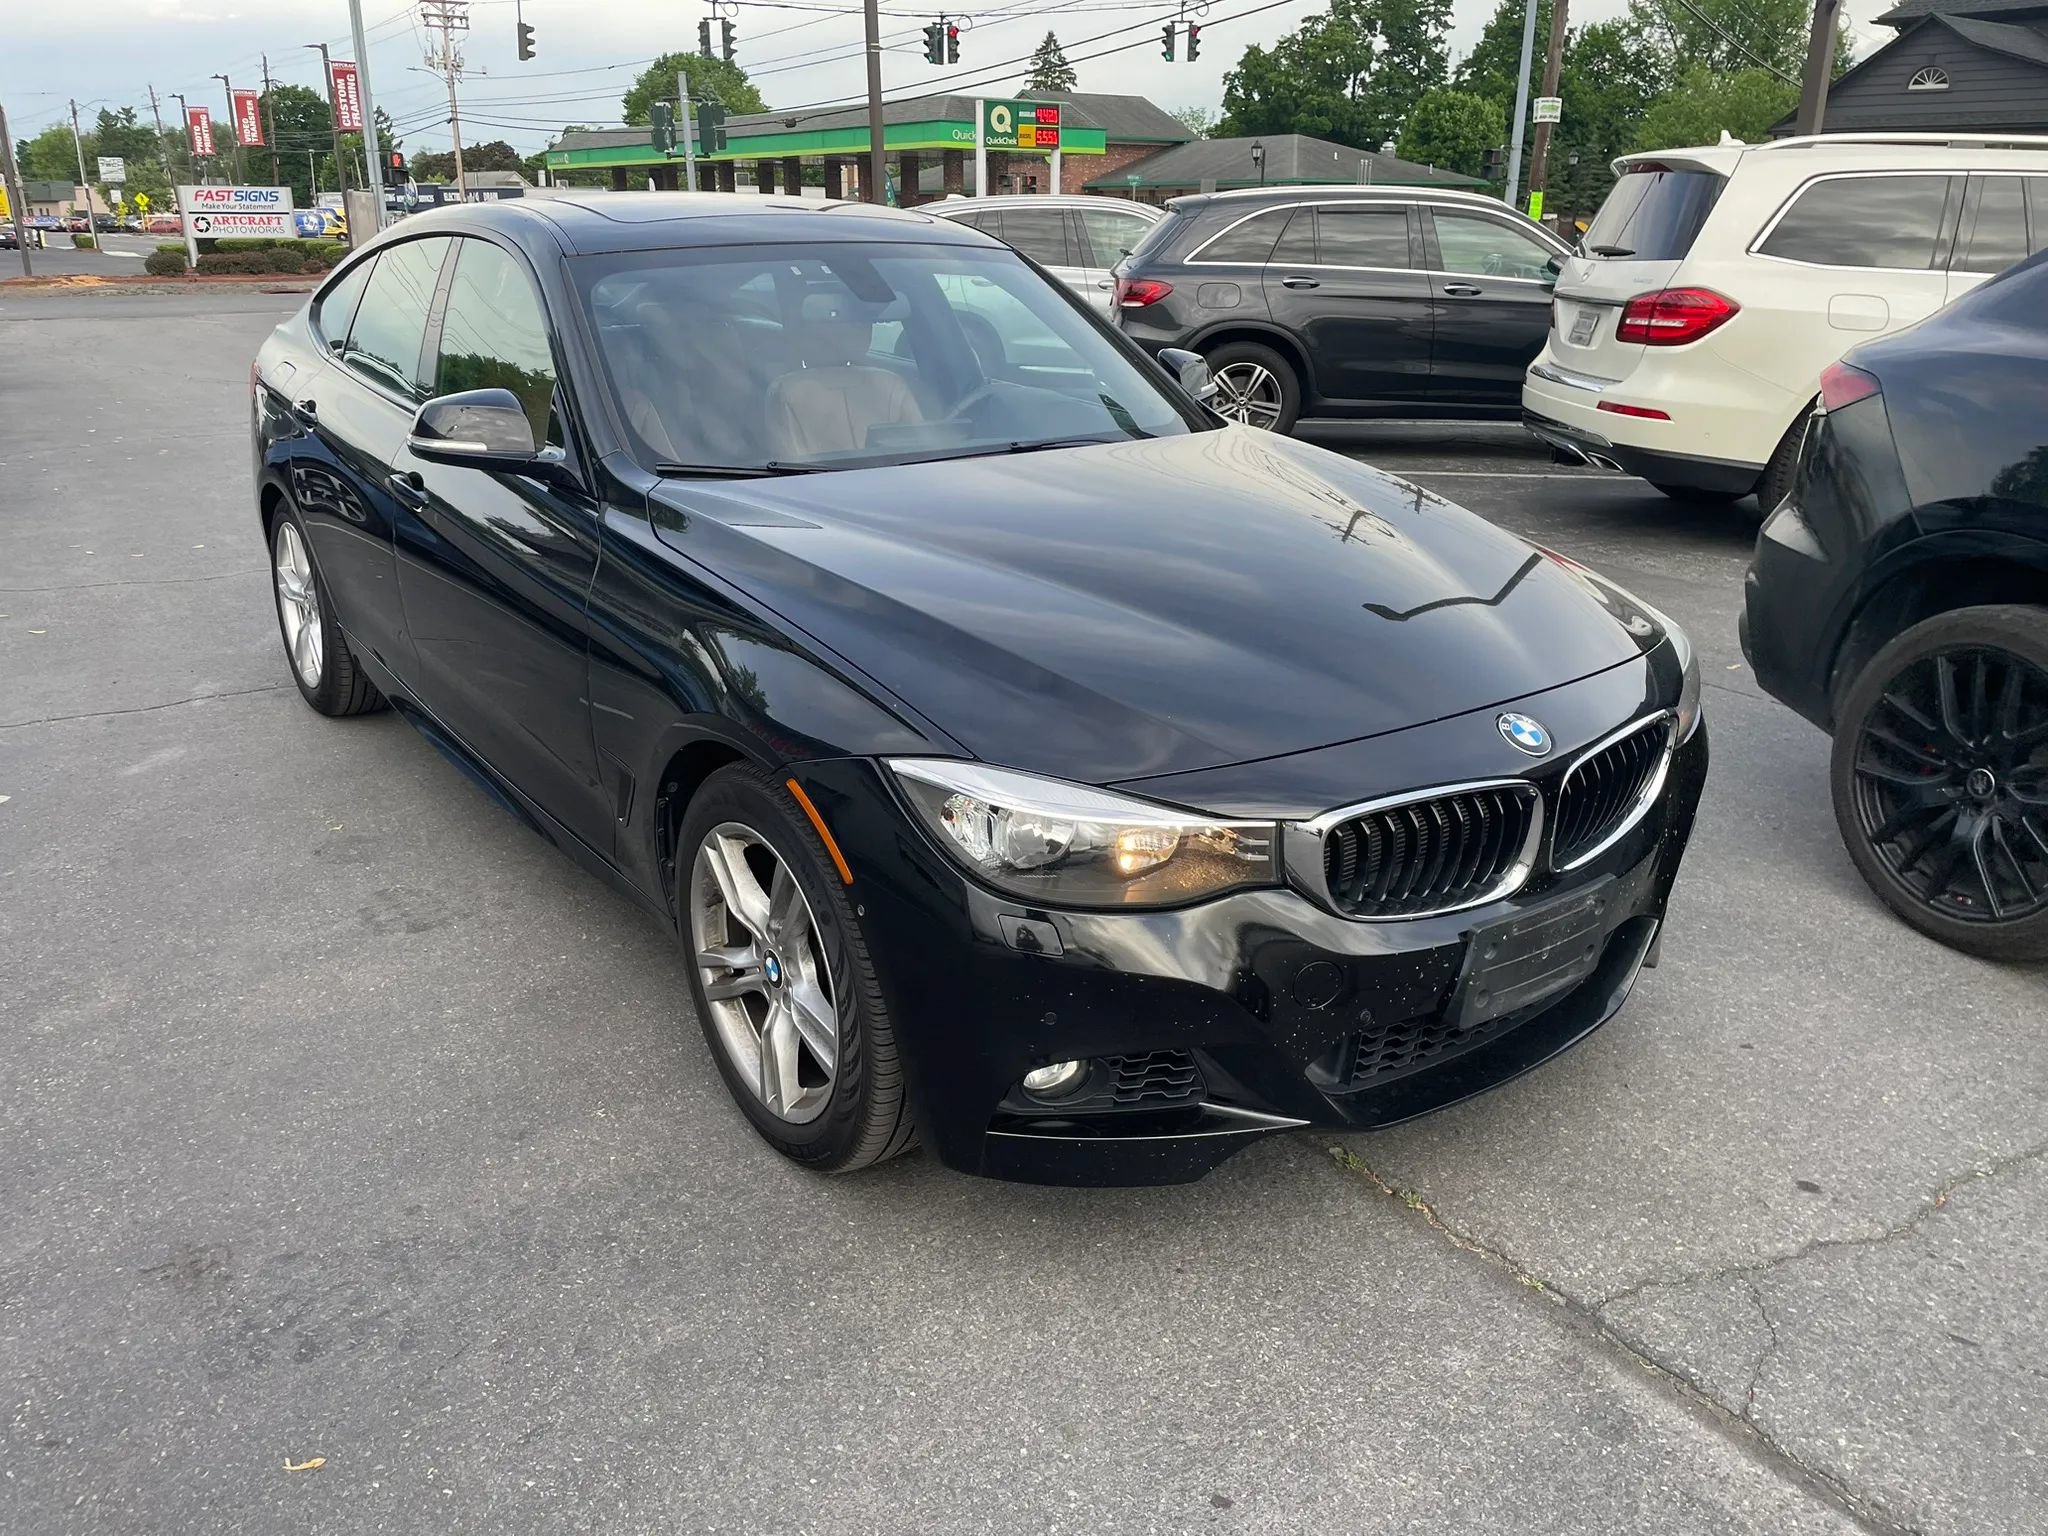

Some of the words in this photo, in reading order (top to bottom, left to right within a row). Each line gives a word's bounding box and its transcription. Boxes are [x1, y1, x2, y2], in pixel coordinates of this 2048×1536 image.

[337, 78, 351, 127] CUSTOM
[347, 74, 362, 127] FRAMING
[242, 118, 252, 143] VIDEO
[246, 100, 259, 143] TRANSFER
[990, 105, 1012, 133] Q
[193, 125, 204, 153] PHOTO
[200, 114, 213, 153] PRINTING
[985, 136, 1018, 145] QuickChek
[194, 190, 280, 202] FASTSIGNS
[212, 216, 283, 226] ARTCRAFT
[213, 225, 286, 234] PHOTOWORKS
